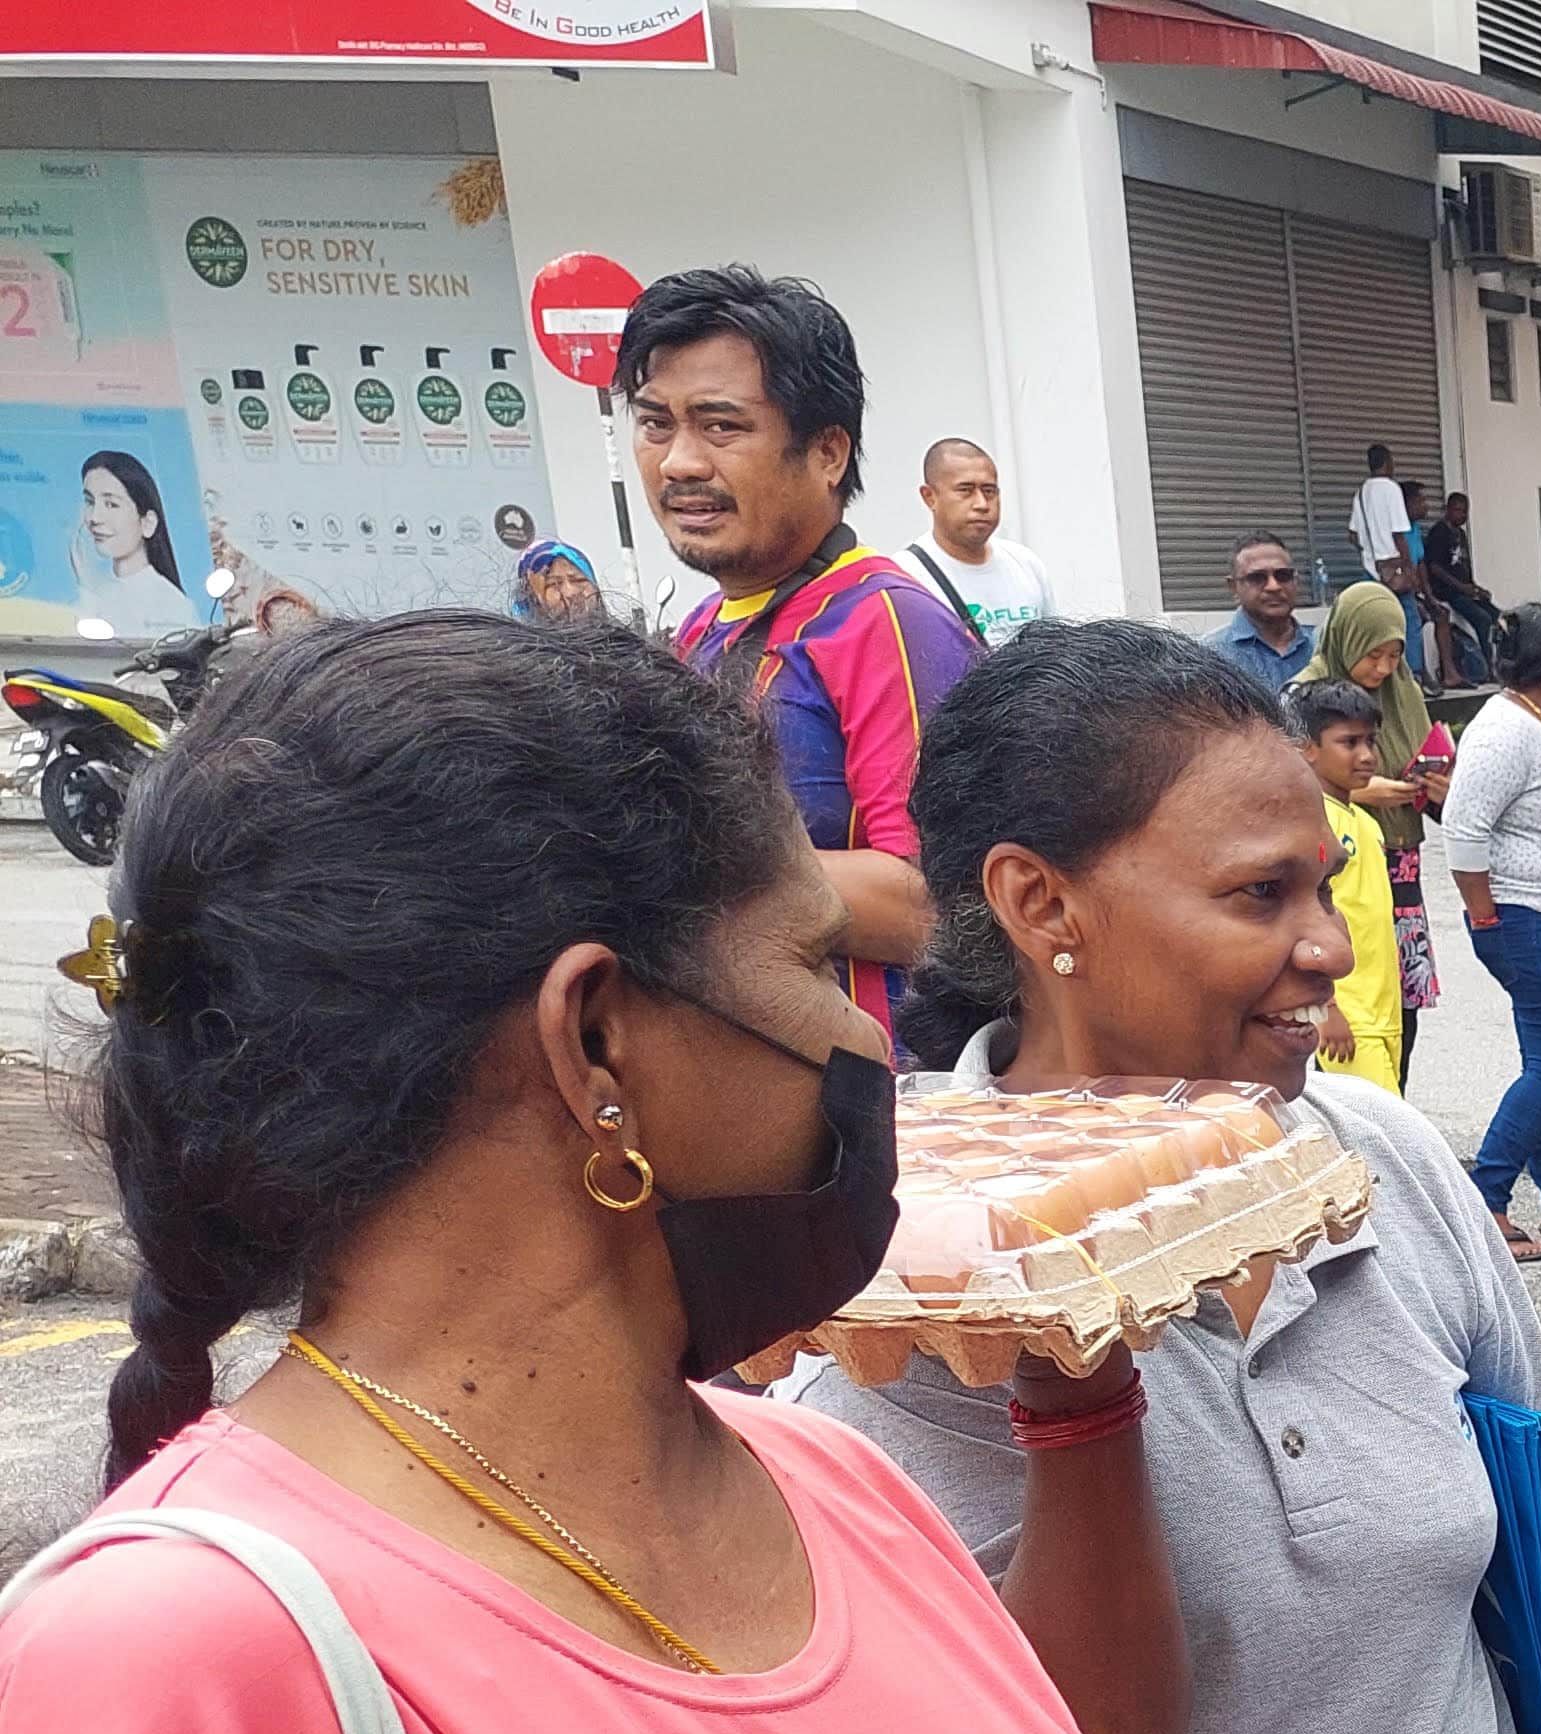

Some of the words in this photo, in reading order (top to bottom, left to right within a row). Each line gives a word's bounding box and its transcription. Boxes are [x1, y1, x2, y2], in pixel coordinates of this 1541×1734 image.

[530, 9, 549, 30] IN
[556, 16, 612, 38] GOOD
[618, 6, 681, 37] HEALTH
[260, 237, 316, 261] FOR
[323, 239, 385, 268] DRY,
[266, 271, 400, 296] SENSITIVE
[408, 273, 471, 297] SKIN
